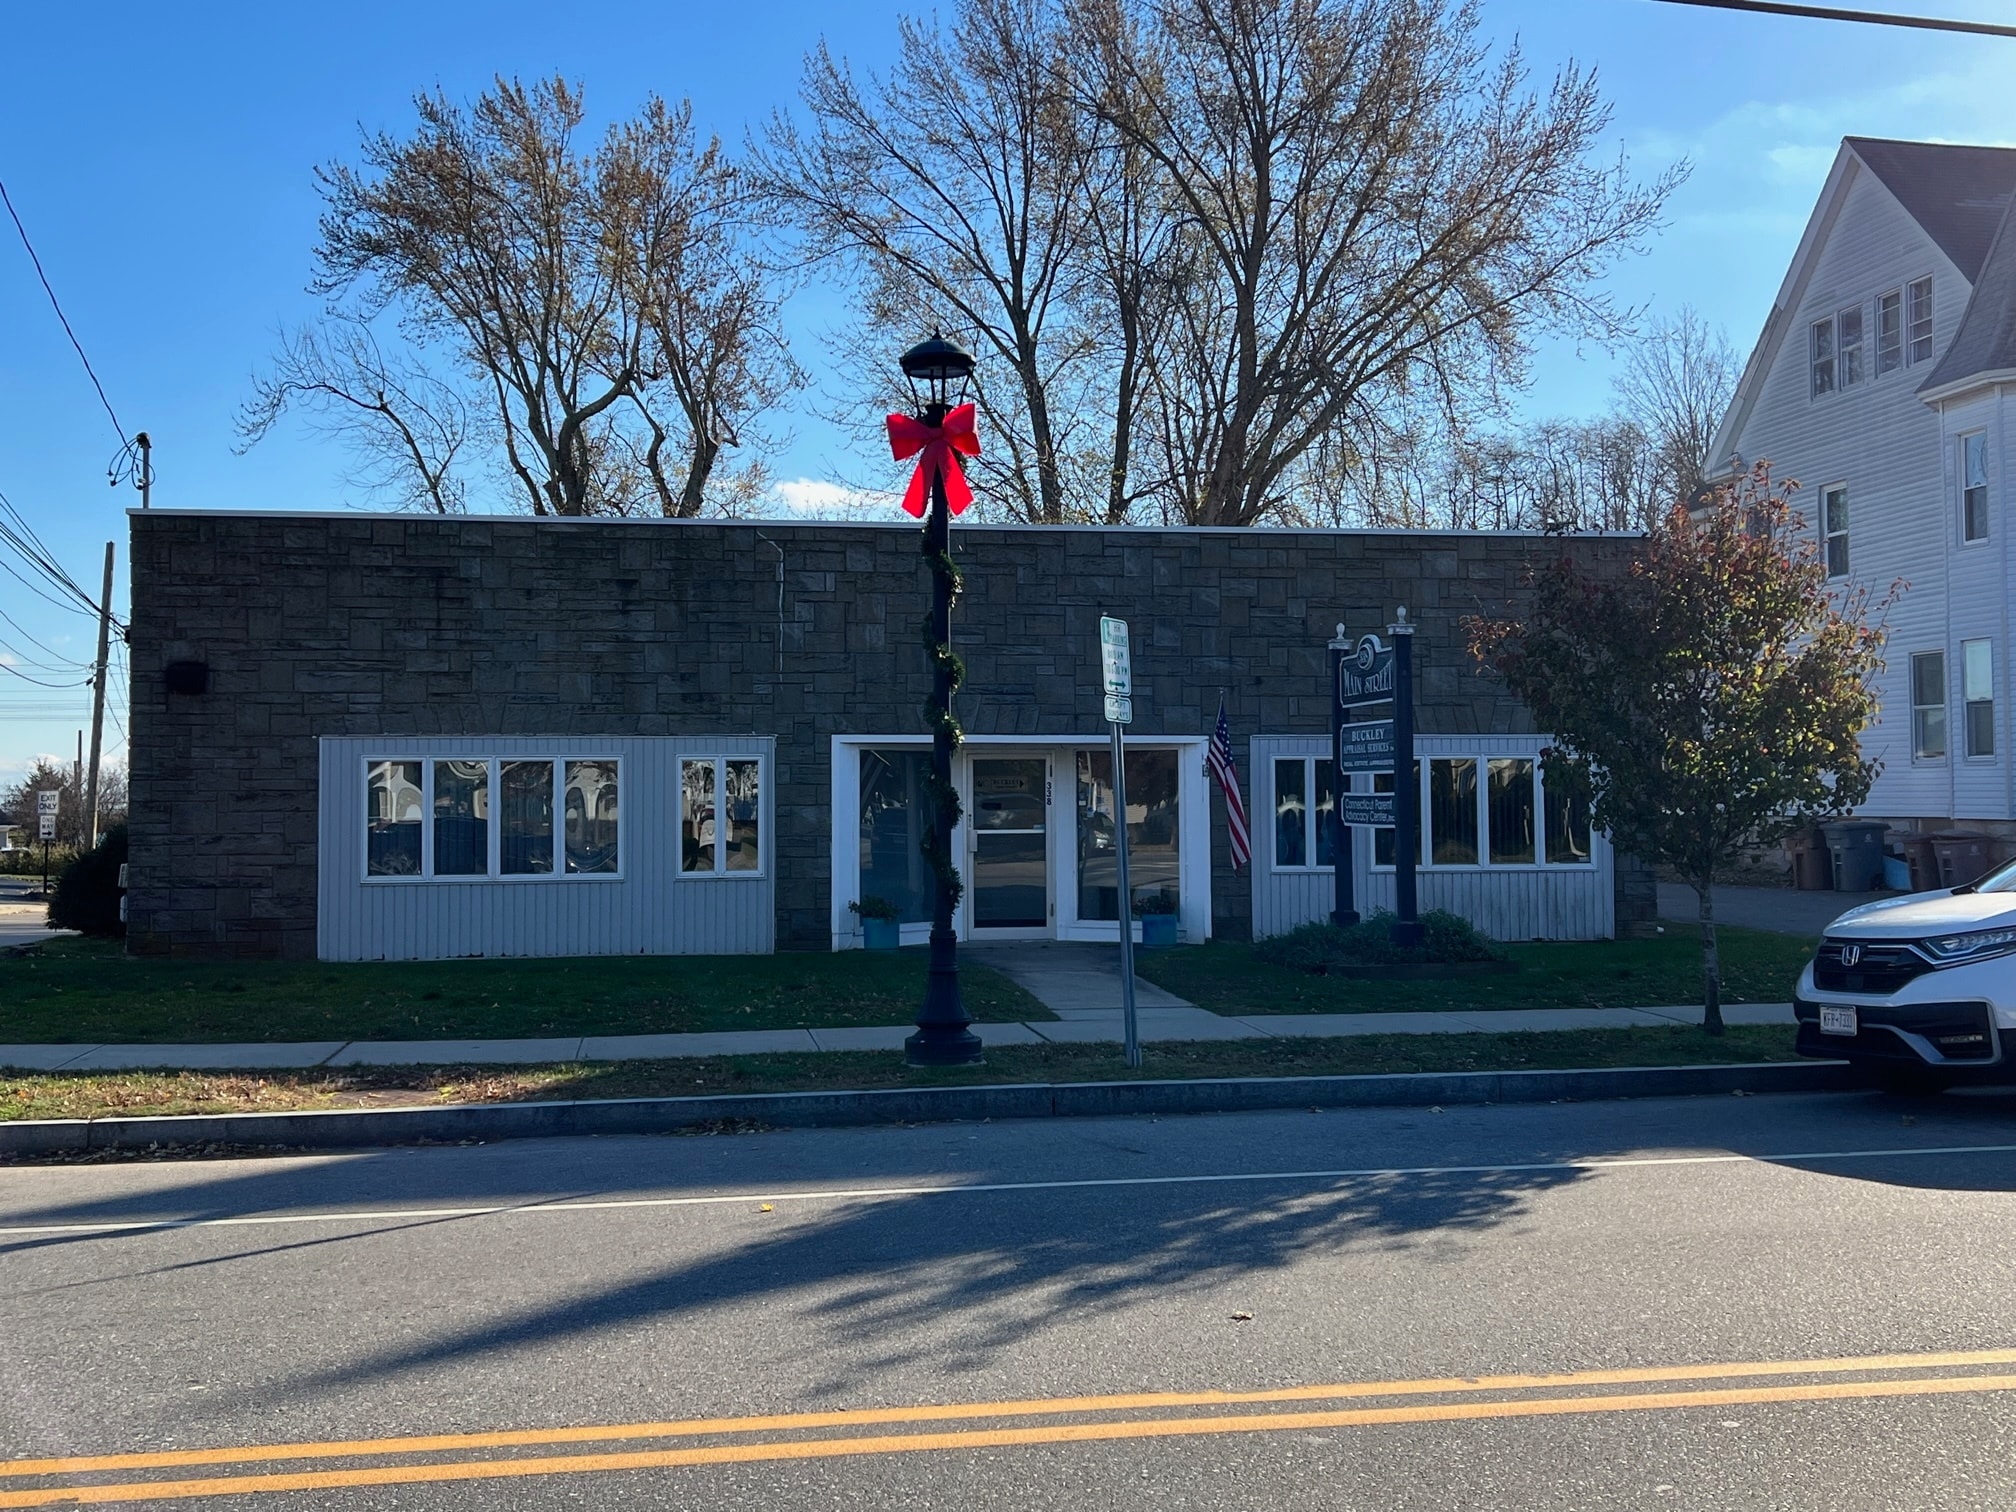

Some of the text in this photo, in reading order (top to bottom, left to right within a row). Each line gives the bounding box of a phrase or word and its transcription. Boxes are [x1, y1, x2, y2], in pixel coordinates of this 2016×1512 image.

[1343, 657, 1393, 697] MAIN STREET
[1351, 728, 1385, 742] BUCKLEY
[1345, 798, 1393, 810] Connecticut Parent
[1345, 810, 1369, 823] Advocacy
